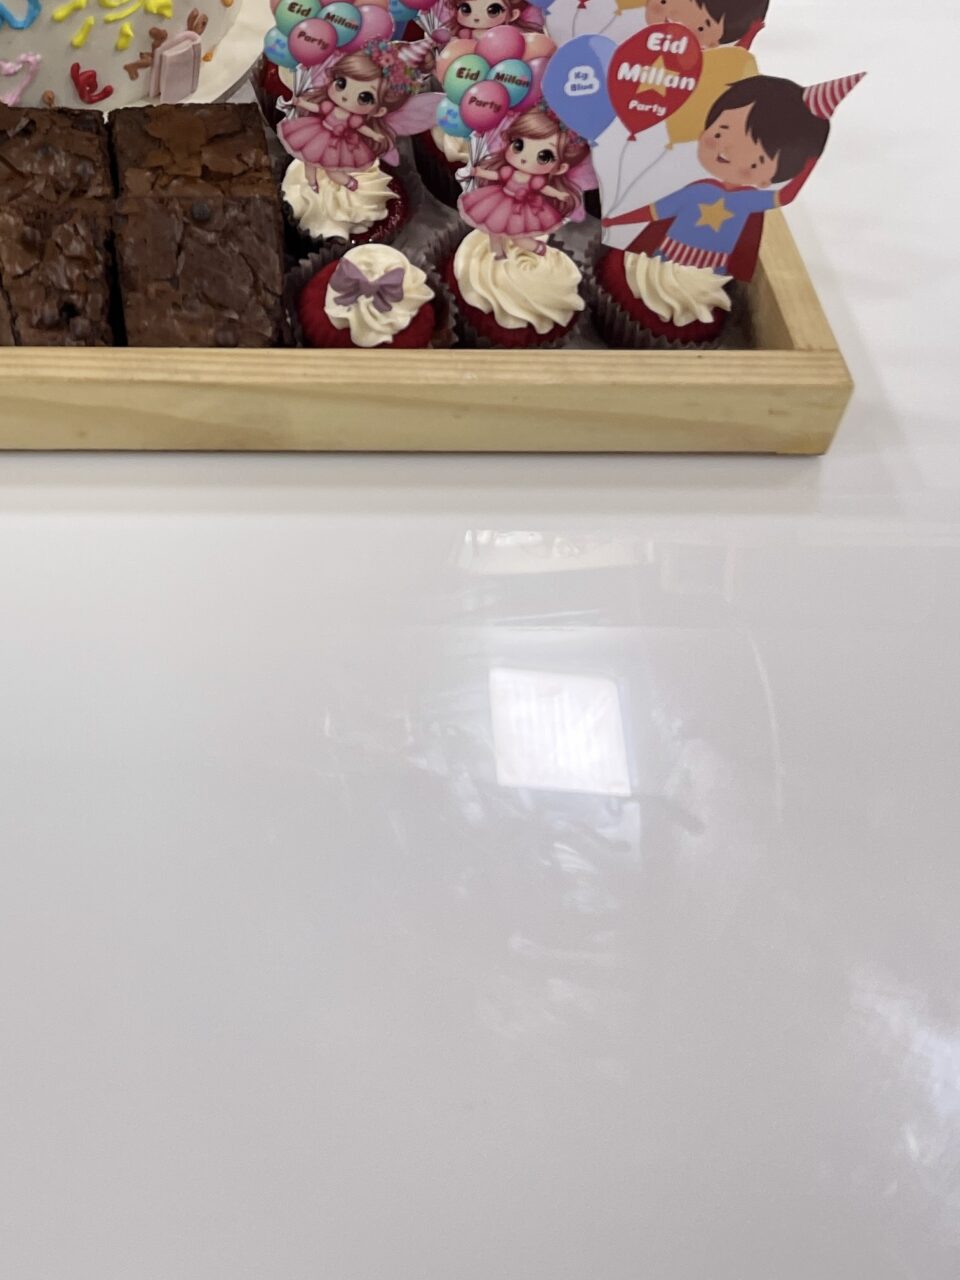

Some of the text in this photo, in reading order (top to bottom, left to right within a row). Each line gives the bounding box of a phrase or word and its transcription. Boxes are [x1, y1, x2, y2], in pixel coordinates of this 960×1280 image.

[287, 2, 360, 31] Eid Millan
[297, 30, 330, 50] Party
[646, 32, 689, 55] Eid
[456, 67, 529, 89] Eid Millan
[617, 62, 696, 91] Millan
[468, 96, 502, 113] Party
[628, 100, 667, 116] Party
